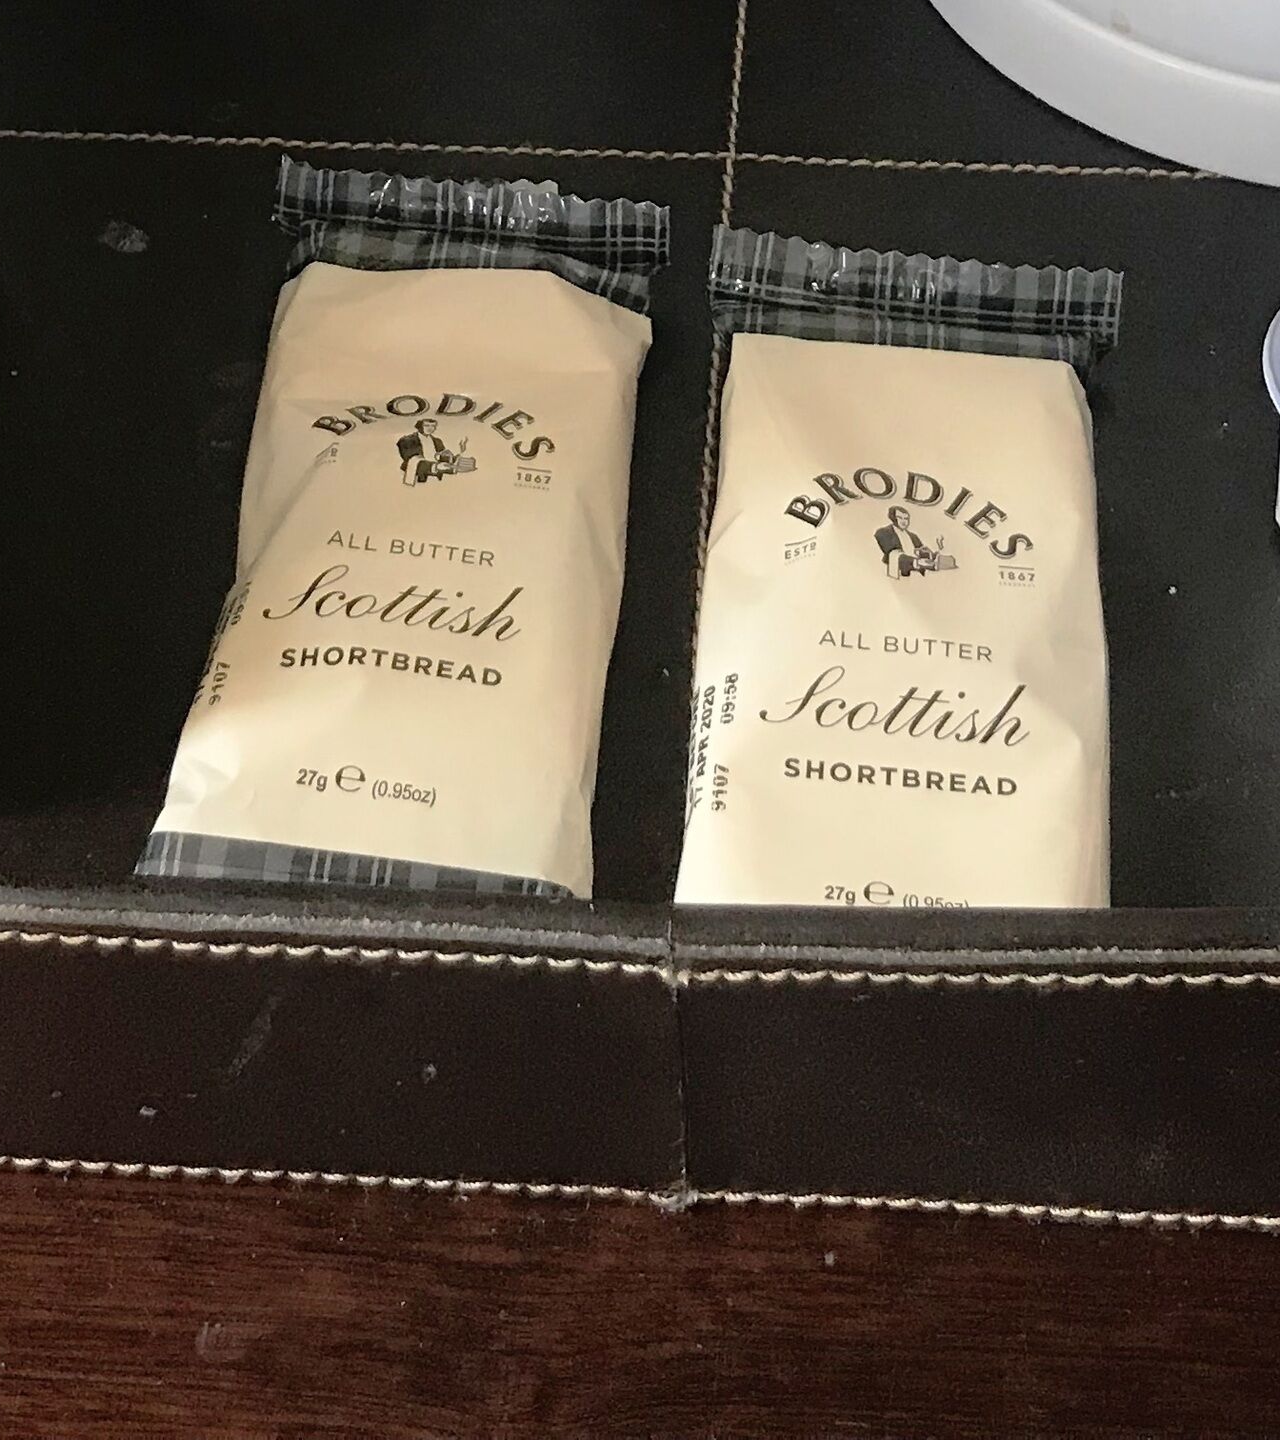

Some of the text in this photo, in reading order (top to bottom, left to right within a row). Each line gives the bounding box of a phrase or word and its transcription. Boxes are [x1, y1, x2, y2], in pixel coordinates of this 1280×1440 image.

[311, 392, 556, 461] BRODIES
[516, 472, 552, 485] 1867
[784, 467, 1035, 560] BRODIES
[327, 530, 496, 568] ALL BUTTER
[999, 571, 1036, 583] 1867
[262, 564, 524, 642] Scottish
[819, 629, 993, 663] ALL BUTTER
[279, 645, 503, 688] SHORTBREAD
[699, 684, 717, 734] 2020
[759, 665, 1030, 748] Scottish
[296, 768, 329, 793] 27g
[372, 779, 437, 808] (0.95oz)
[783, 757, 1018, 797] SHORTBREAD
[825, 885, 856, 906] 27g
